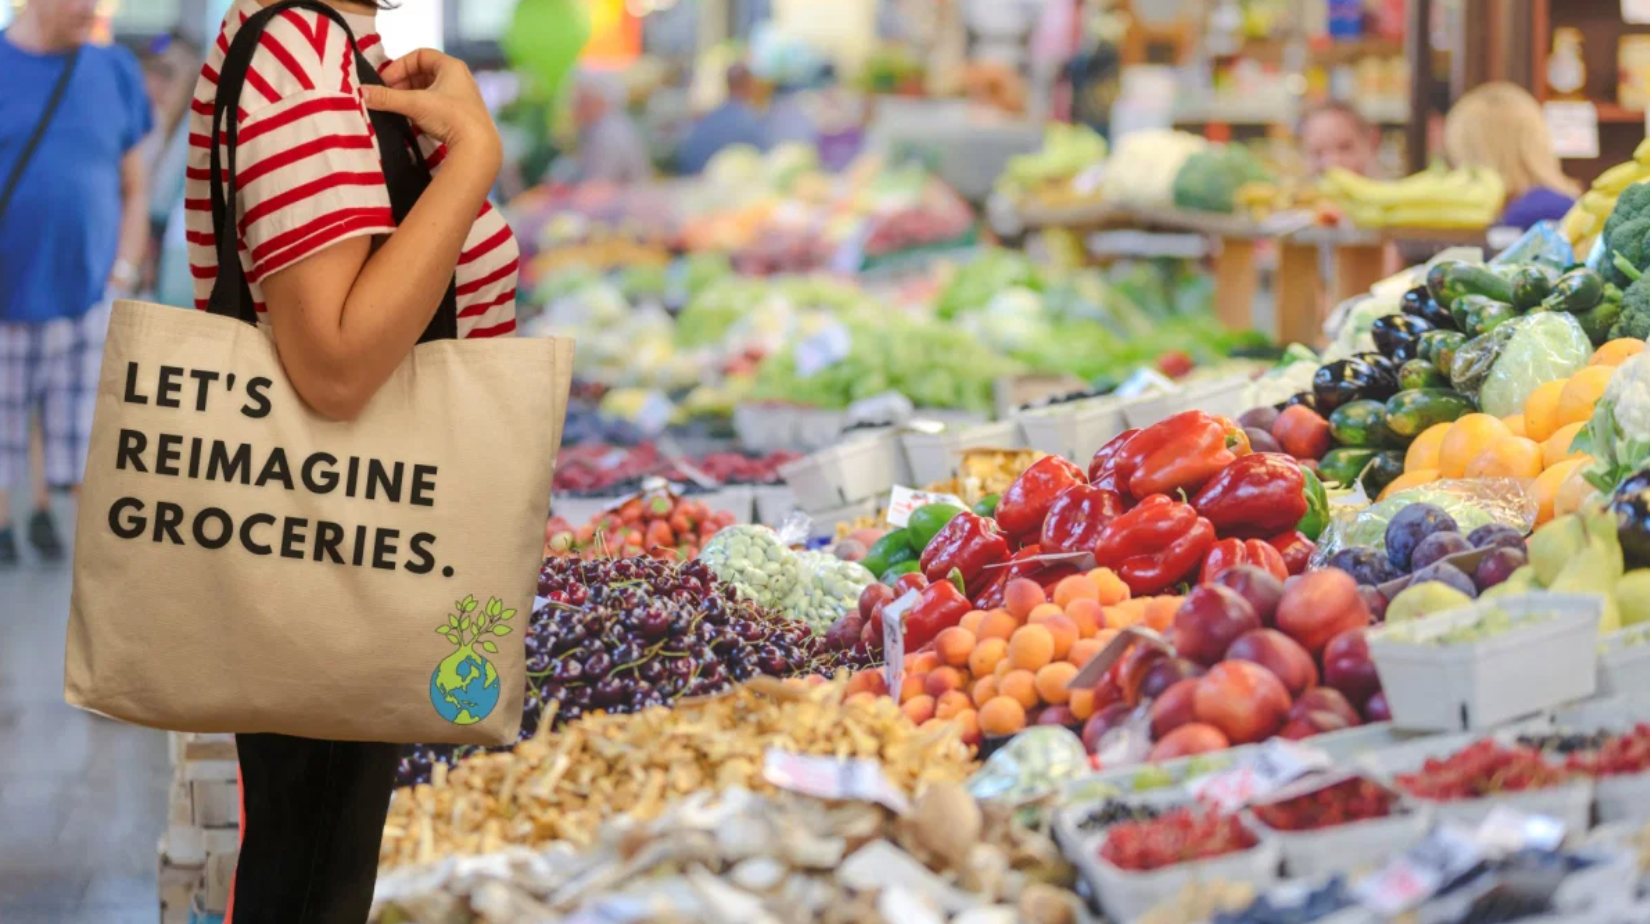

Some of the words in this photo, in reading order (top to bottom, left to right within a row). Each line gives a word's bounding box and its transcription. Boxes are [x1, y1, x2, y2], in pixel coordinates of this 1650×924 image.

[124, 361, 273, 419] LET'S
[115, 428, 438, 507] REIMAGINE
[107, 496, 455, 578] GROCERIES.
